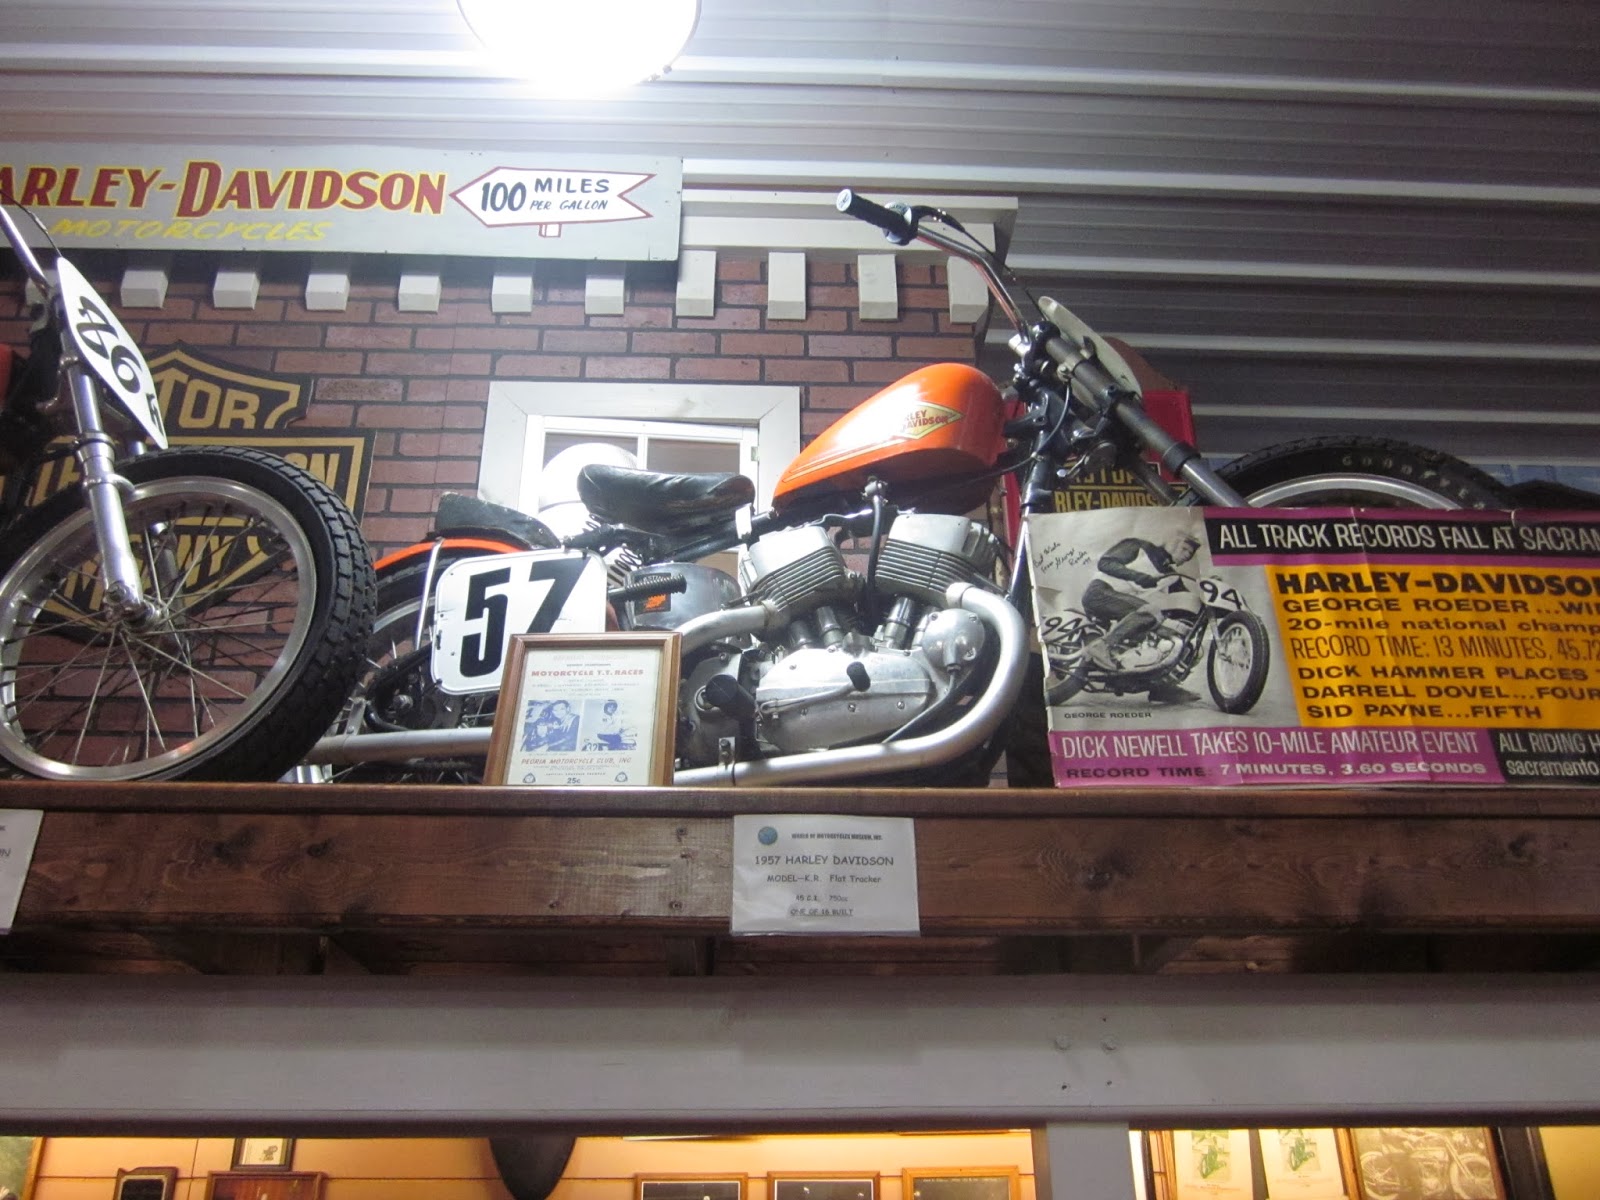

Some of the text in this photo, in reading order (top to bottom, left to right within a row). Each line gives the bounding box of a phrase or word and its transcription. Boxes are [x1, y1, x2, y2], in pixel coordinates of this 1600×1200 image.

[481, 177, 610, 212] 100 MILES
[530, 199, 608, 211] PER GALLON
[51, 218, 333, 241] MOTORCYCLES
[1219, 524, 1257, 549] ALL
[1258, 523, 1331, 549] TRACK
[1334, 523, 1435, 549] RECORDS
[1439, 525, 1490, 550] FALL
[1492, 526, 1515, 549] AT
[1199, 579, 1243, 611] 94
[1283, 598, 1401, 613] GEORGE
[1413, 599, 1530, 614] ROEDER
[459, 556, 592, 678] 57
[1287, 617, 1390, 631] 20-mile
[1401, 617, 1506, 632] national
[1290, 634, 1370, 660] RECORD
[1375, 634, 1429, 659] TIME:
[1433, 635, 1455, 659] 13
[531, 669, 594, 677] MOTORCYCLE
[1298, 665, 1588, 681] DICK HAMMER PLACES
[1302, 685, 1416, 699] DARRELL
[1064, 711, 1152, 719] GEORGE ROEDER
[1307, 705, 1353, 719] SID
[1061, 730, 1478, 759] DICK NEWELL TAKES 10-MILE AMATEUR EVENT
[1498, 732, 1527, 753] ALL
[1528, 732, 1586, 754] RIDING
[550, 757, 593, 765] MOTORCYCLE
[1506, 759, 1600, 776] sacramento
[1066, 767, 1150, 779] RECORD
[1219, 764, 1229, 775] 7
[1340, 764, 1387, 776] 3.60
[1391, 762, 1487, 774] SECONDS
[755, 855, 894, 866] 1957 HARLEY DAVIDSON
[829, 874, 846, 883] Flat
[850, 874, 881, 883] Tracker
